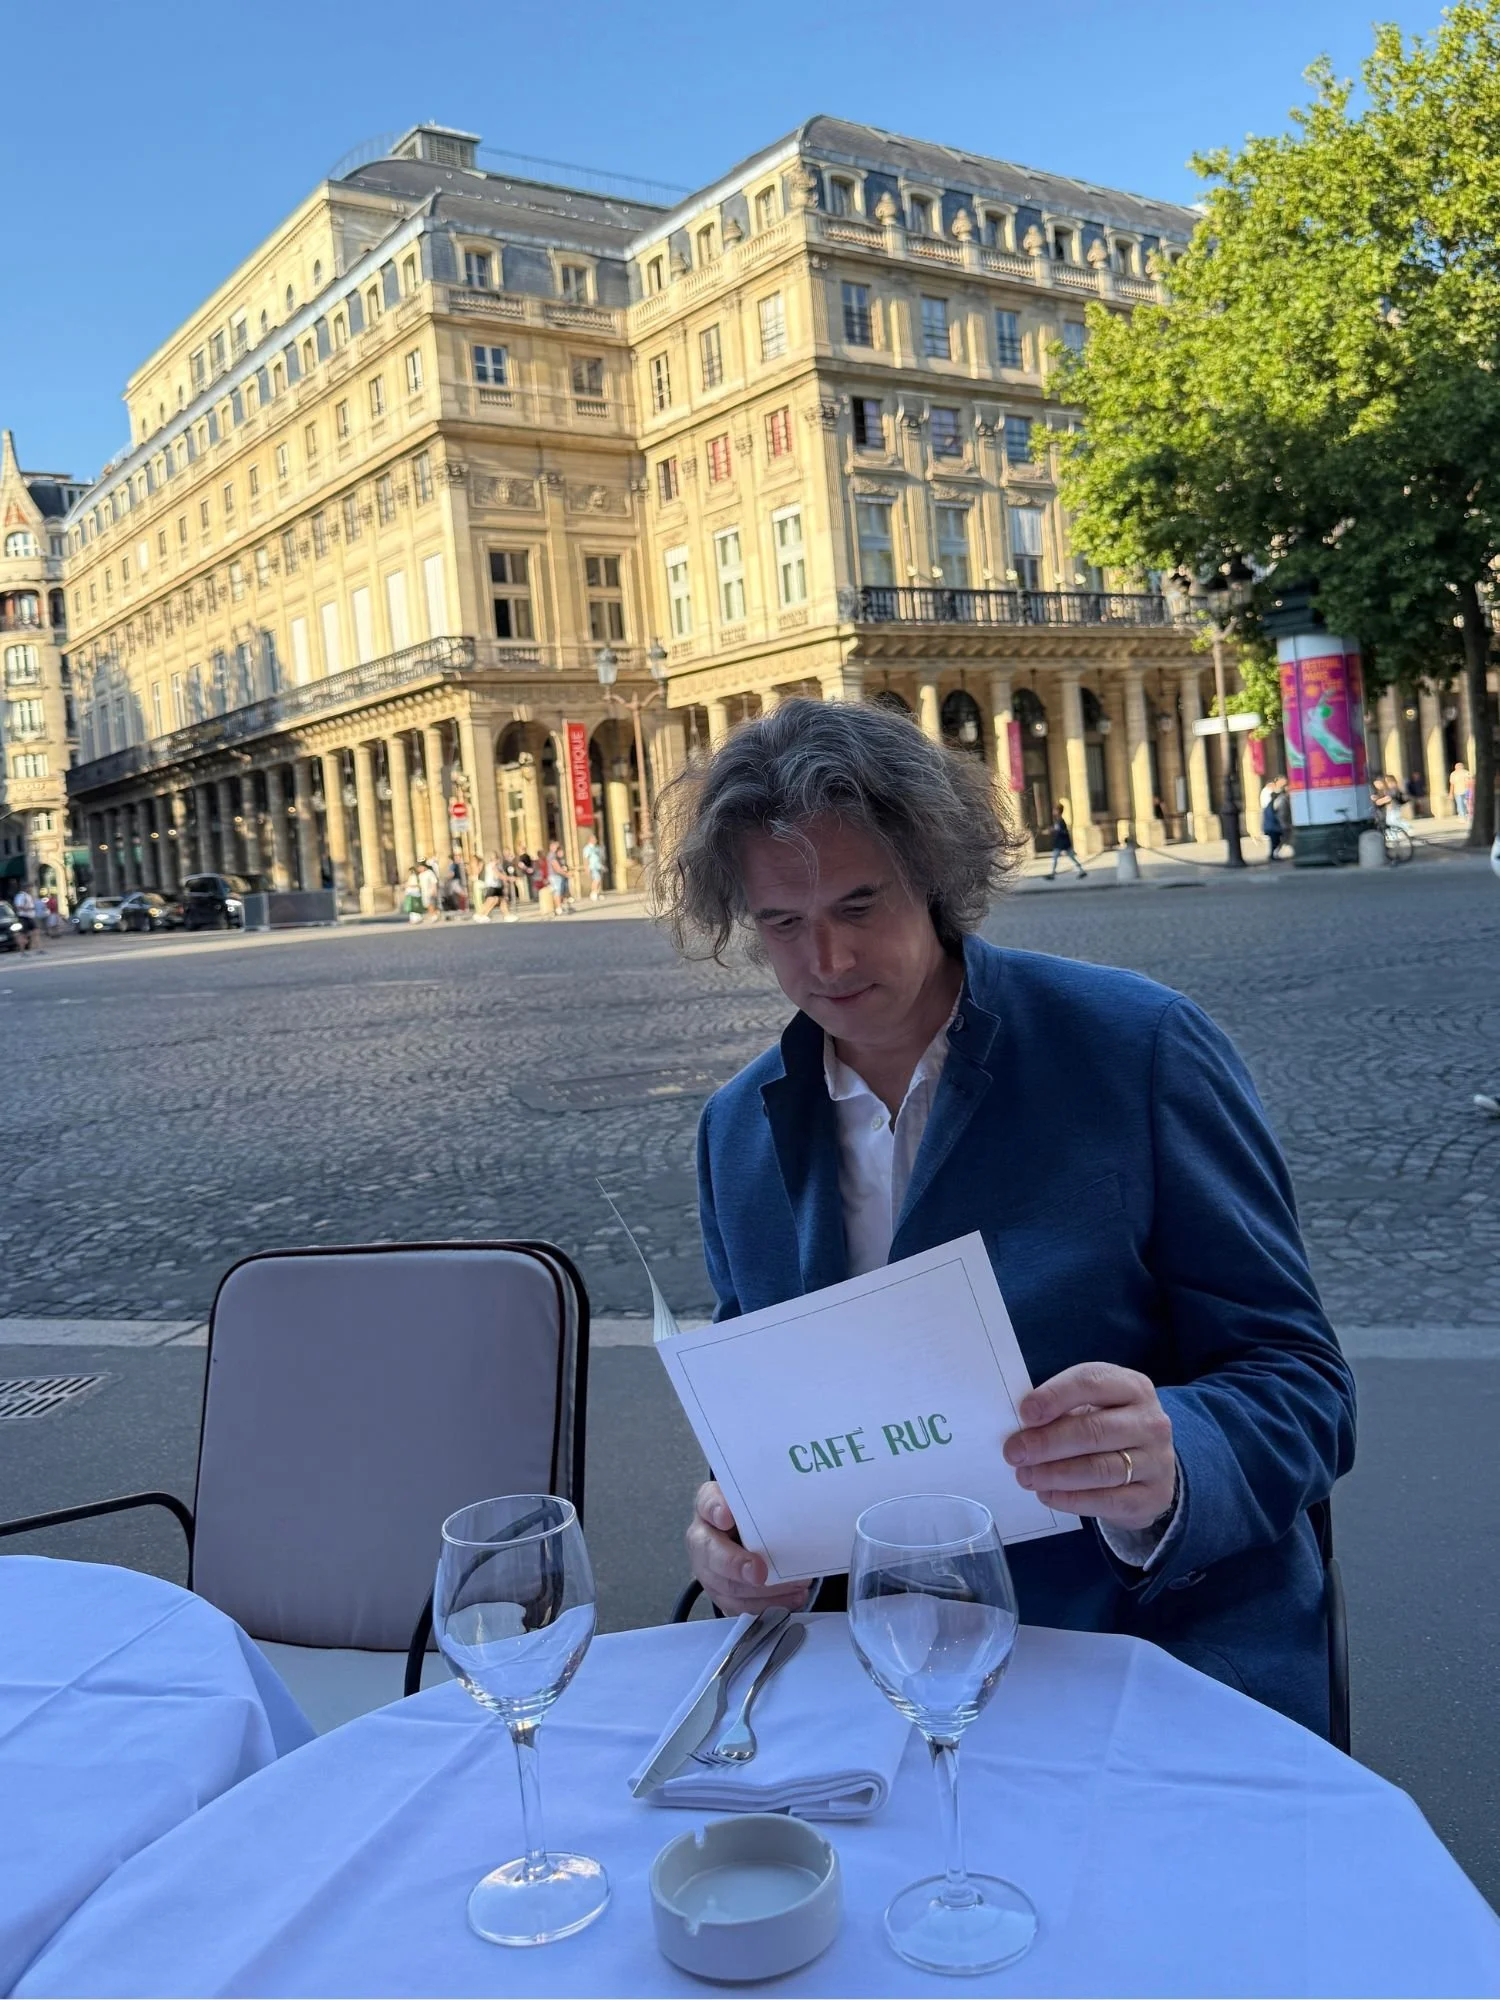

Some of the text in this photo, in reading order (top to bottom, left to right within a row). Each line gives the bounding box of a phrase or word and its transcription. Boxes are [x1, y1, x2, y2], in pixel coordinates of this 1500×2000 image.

[572, 731, 589, 801] BOUTIQUE
[788, 1413, 953, 1473] CAFÉ RUC
